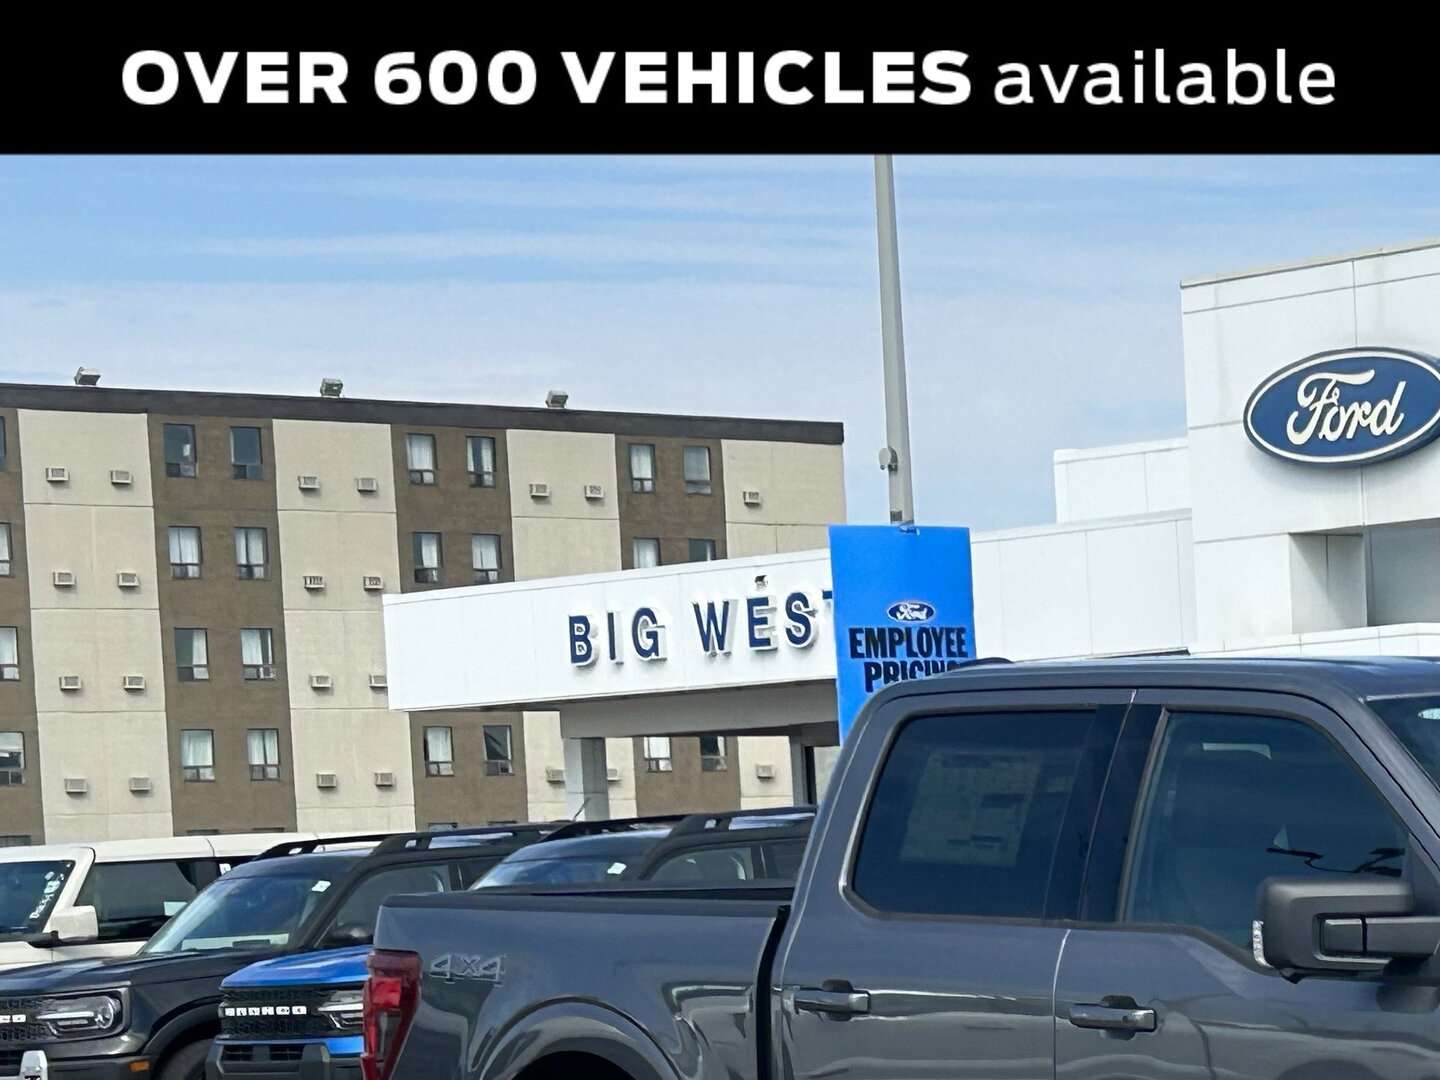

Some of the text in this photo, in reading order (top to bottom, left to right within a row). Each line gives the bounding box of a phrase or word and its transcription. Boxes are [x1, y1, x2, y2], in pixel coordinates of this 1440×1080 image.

[1286, 369, 1407, 446] Ford
[568, 590, 832, 666] BIG WES
[849, 626, 968, 659] EMPLOYEE
[864, 660, 958, 693] PRIC
